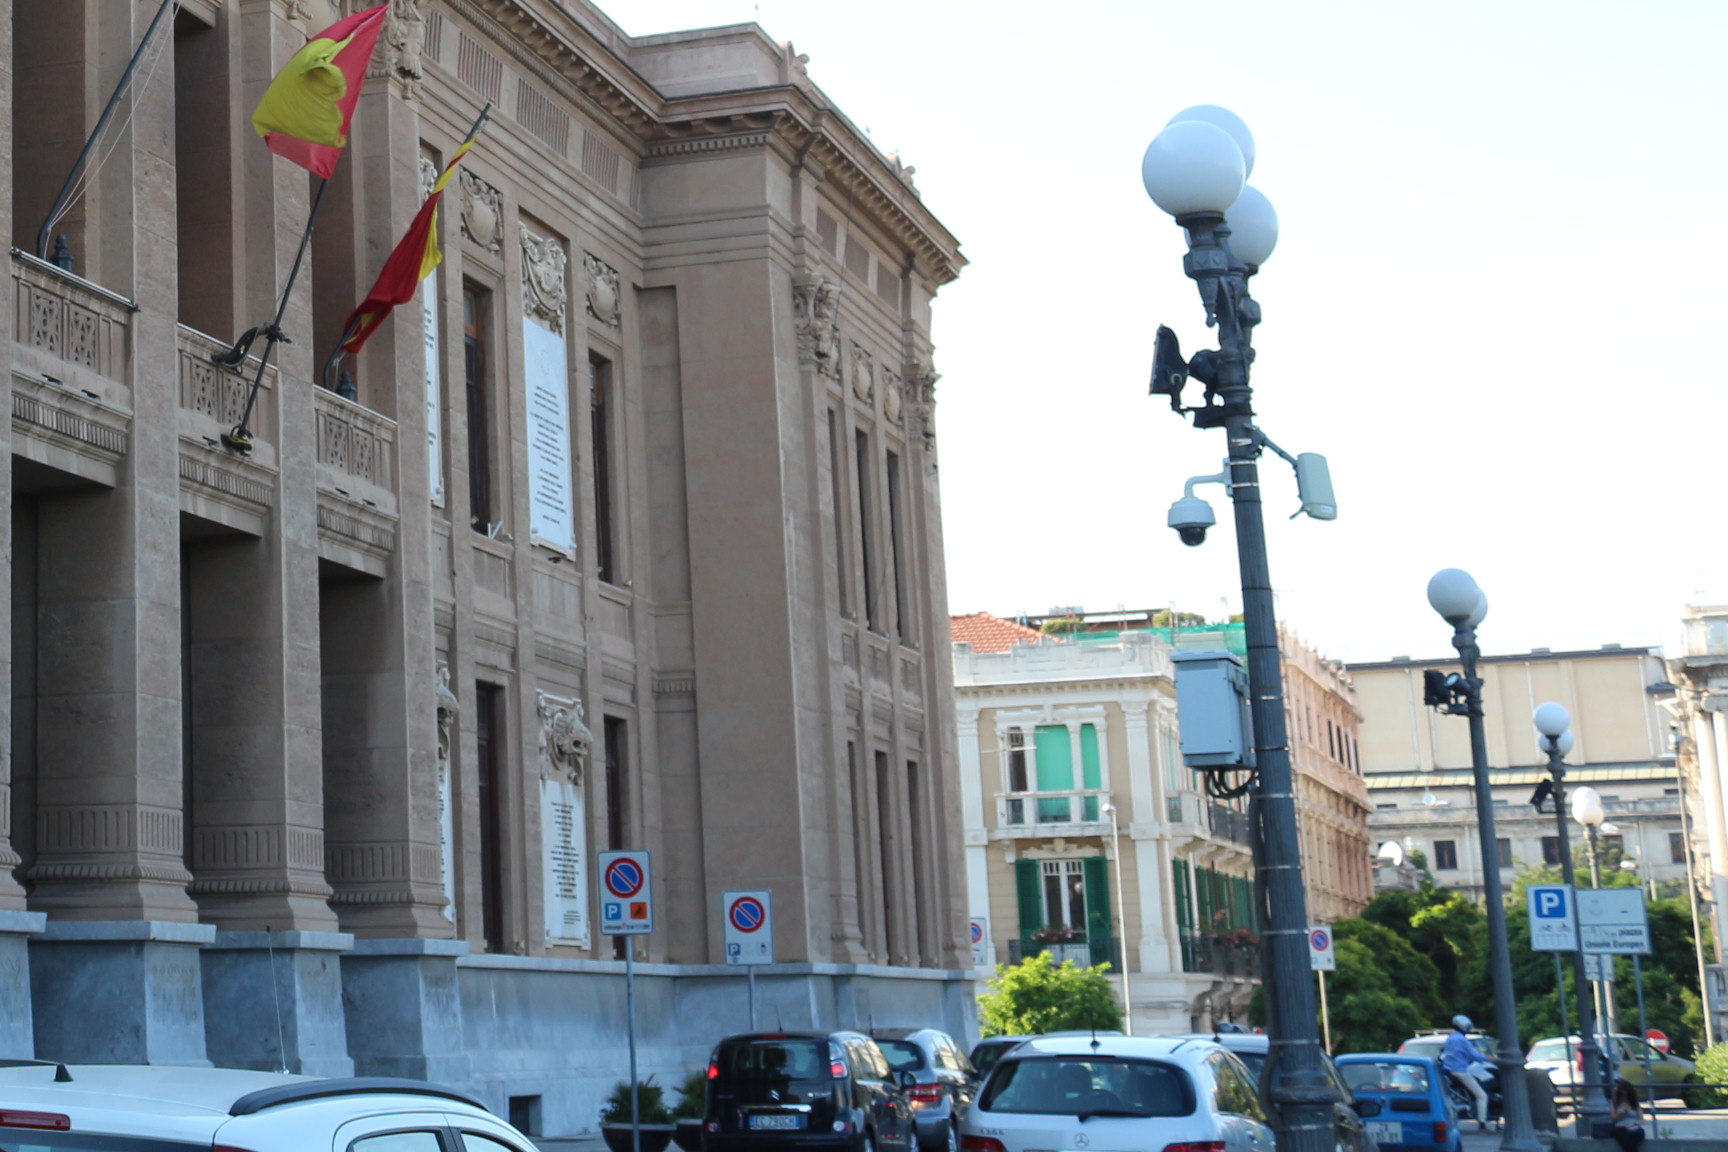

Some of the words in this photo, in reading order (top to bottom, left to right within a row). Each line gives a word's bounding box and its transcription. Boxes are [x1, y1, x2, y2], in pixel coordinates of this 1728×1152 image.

[1540, 892, 1560, 915] P
[608, 905, 618, 918] P
[730, 944, 738, 954] P
